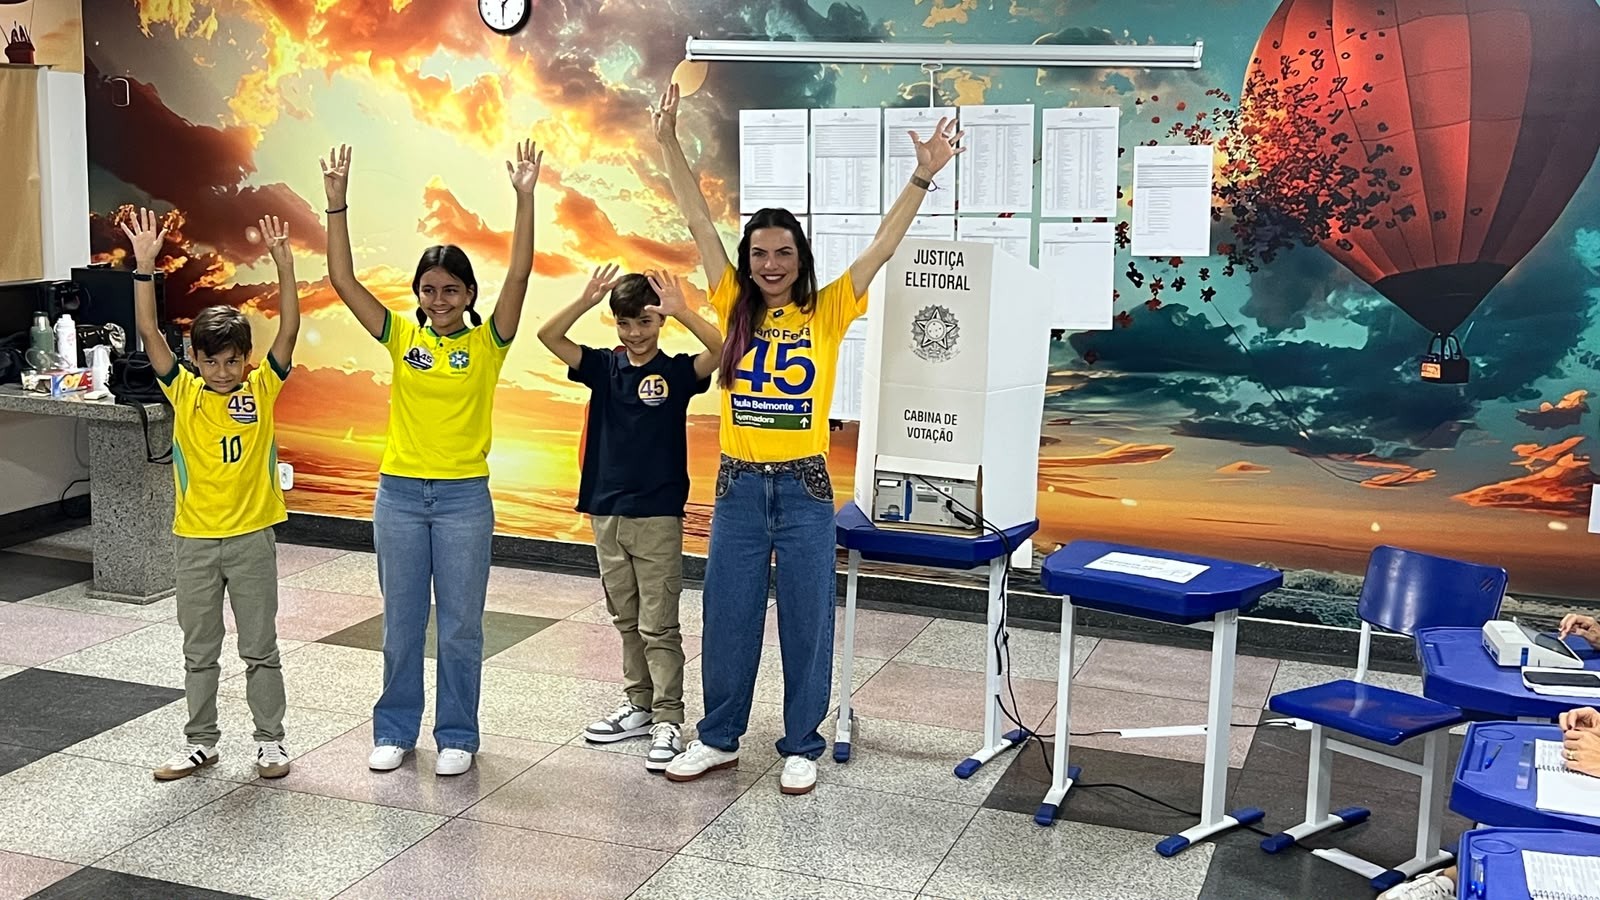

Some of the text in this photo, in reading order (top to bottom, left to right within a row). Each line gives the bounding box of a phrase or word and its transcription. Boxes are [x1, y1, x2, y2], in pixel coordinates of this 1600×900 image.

[914, 249, 964, 270] JUSTIÇA
[905, 271, 971, 291] ELEITORAL
[420, 353, 433, 364] 45
[735, 338, 816, 395] 45
[639, 379, 665, 396] 45
[228, 395, 256, 413] 45
[751, 400, 794, 411] Belmonte
[904, 409, 958, 426] CABINA DE
[907, 426, 954, 443] VOTAÇÃO
[219, 435, 242, 463] 10
